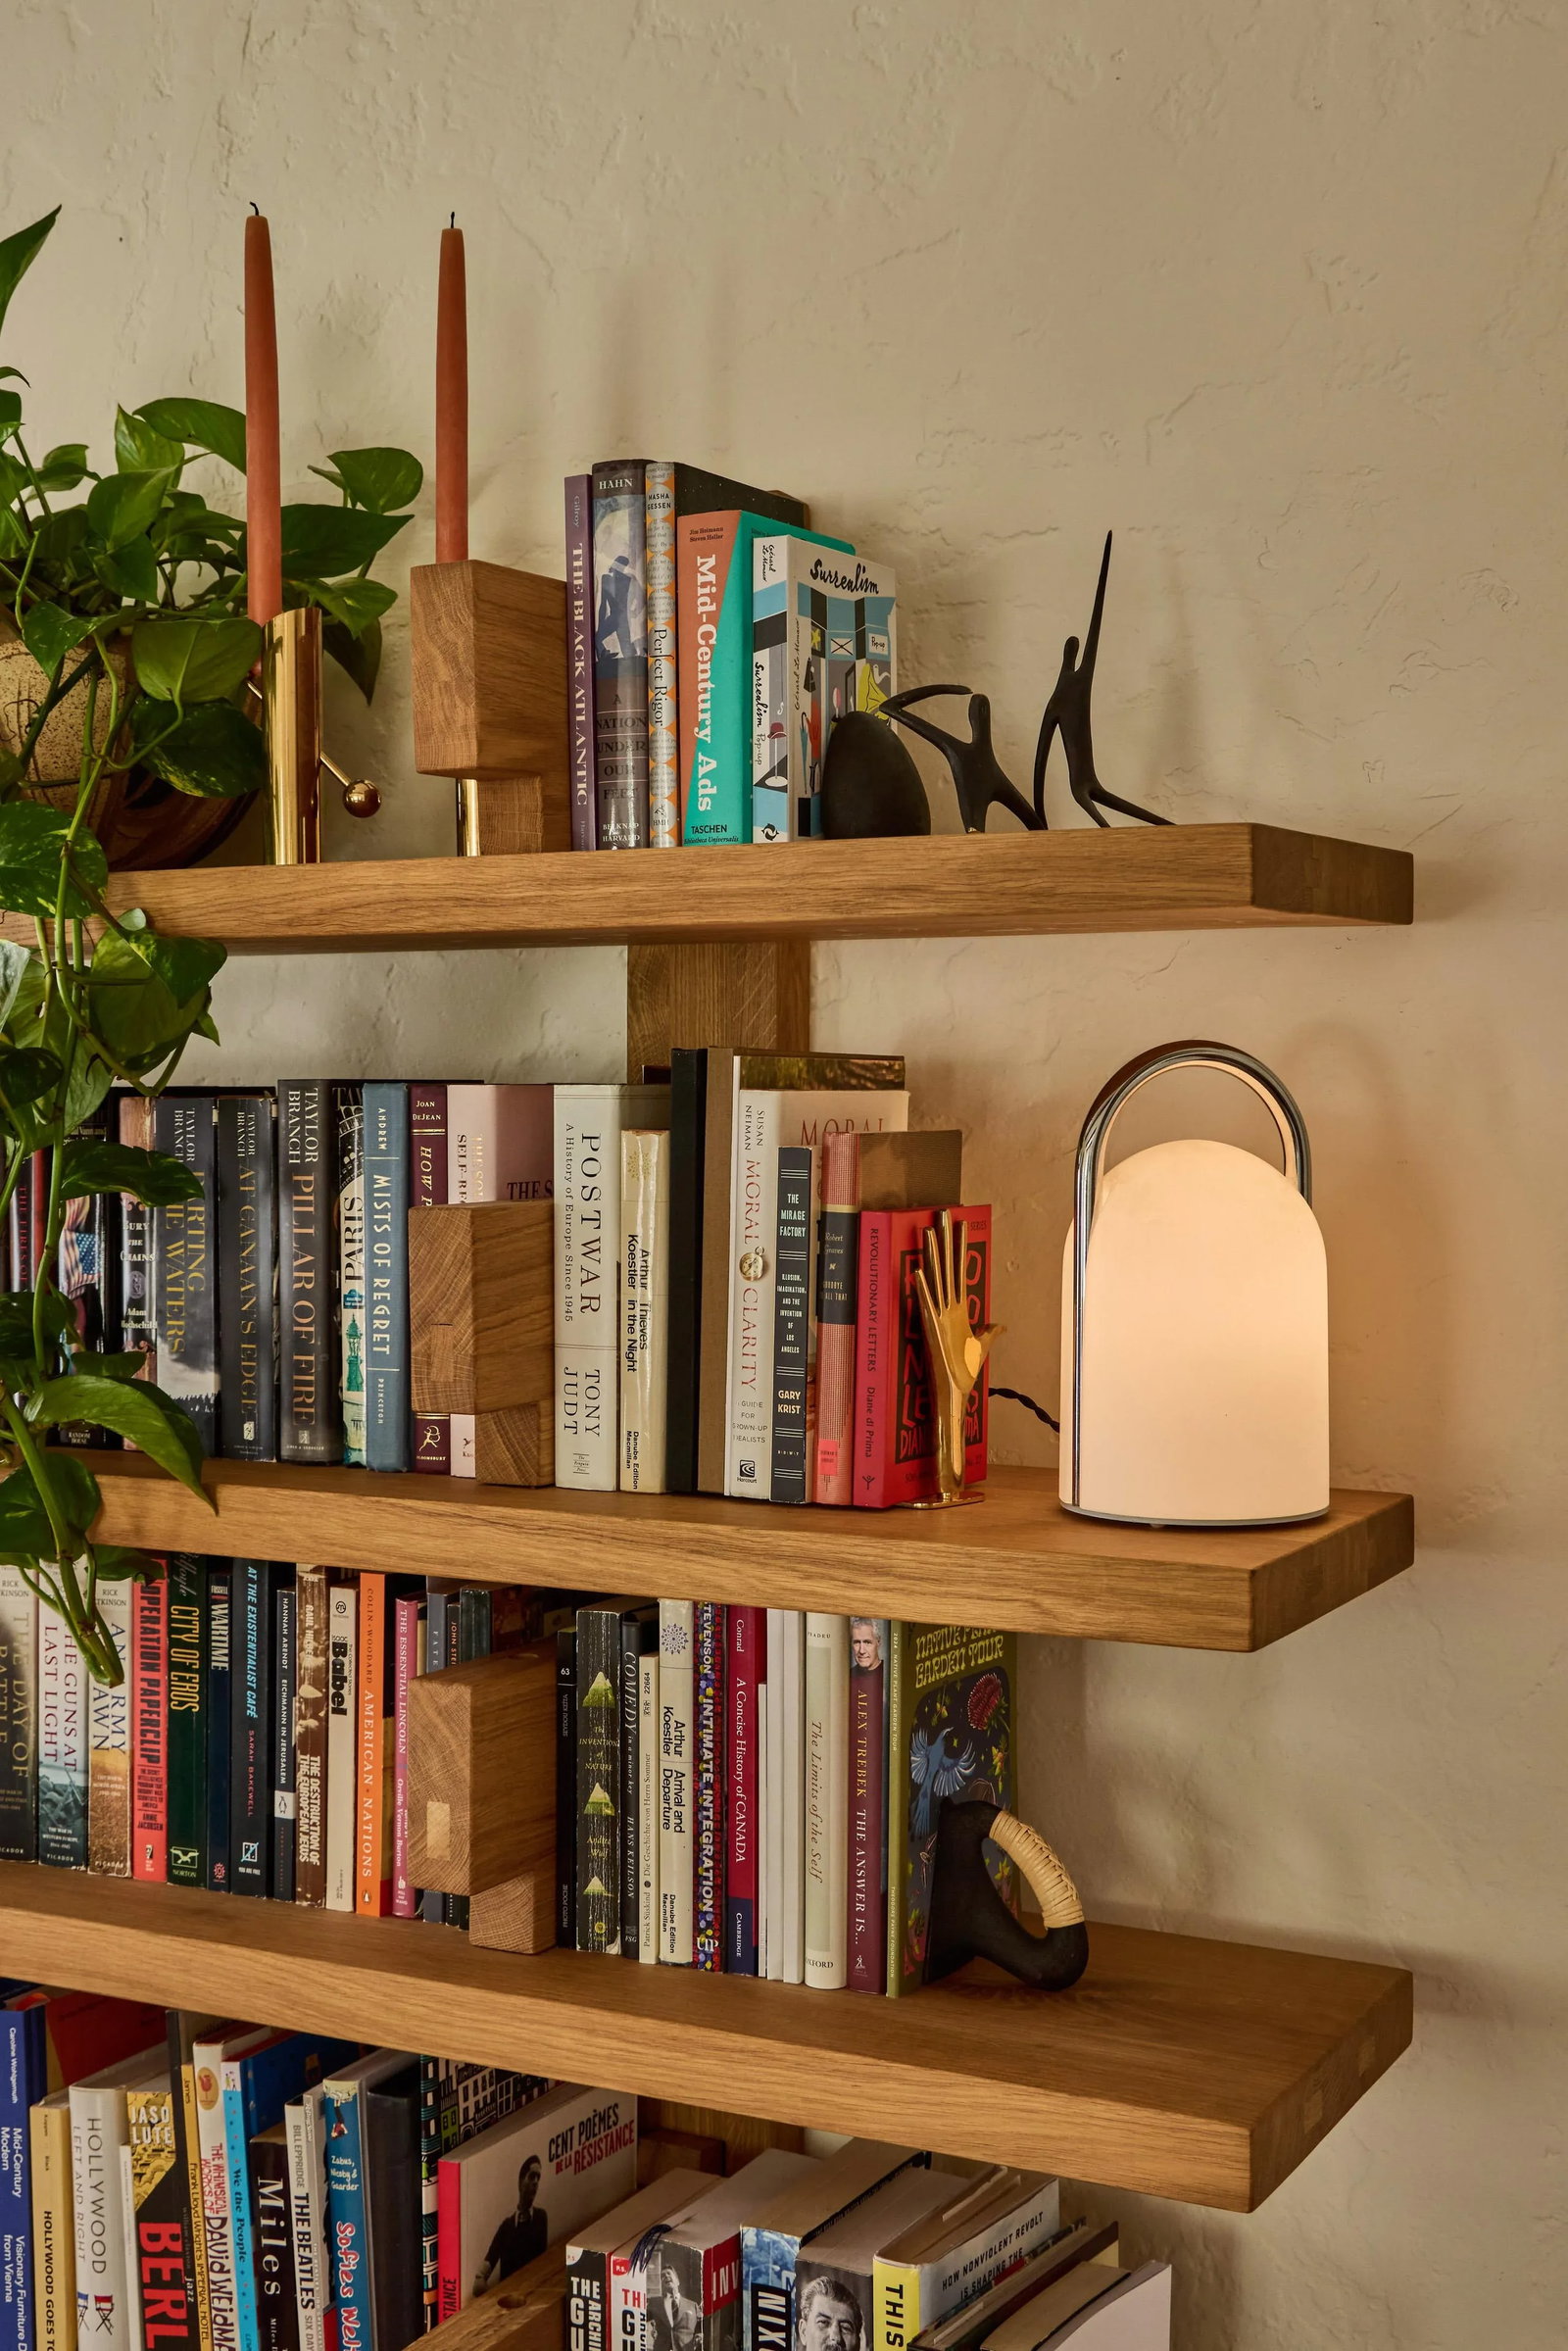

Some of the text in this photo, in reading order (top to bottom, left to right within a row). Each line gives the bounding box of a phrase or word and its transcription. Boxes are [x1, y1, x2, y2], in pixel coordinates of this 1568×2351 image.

[599, 478, 633, 490] HAHN
[572, 542, 584, 594] THE
[809, 559, 879, 595] Surrealism
[573, 600, 586, 678] BLACK
[694, 554, 717, 812] Mid-Century Ads
[575, 684, 588, 806] ATLANTIC
[596, 716, 647, 731] NATION
[597, 740, 647, 754] UNDER
[691, 824, 727, 835] TASCHEN
[186, 1107, 195, 1161] TAYLOR
[288, 1091, 301, 1164] BRANCH
[305, 1088, 318, 1163] TAYLOR
[565, 1123, 574, 1132] A
[757, 1109, 765, 1147] SUSAN
[420, 1146, 432, 1191] HOW
[564, 1137, 574, 1183] History
[565, 1187, 573, 1200] of
[580, 1133, 602, 1314] POSTWAR
[780, 1208, 806, 1221] MIRAGE
[788, 1194, 799, 1203] THE
[344, 1196, 364, 1284] PARIS
[564, 1204, 574, 1249] Europe
[779, 1226, 806, 1238] FACTORY
[239, 1165, 257, 1414] AT CANAAN'S EDGE
[372, 1174, 391, 1355] MISTS OF REGRET
[627, 1234, 638, 1290] Koestler
[640, 1249, 650, 1291] Arthur
[741, 1159, 760, 1392] MORAL CLARITY
[166, 1240, 186, 1352] WATERS
[292, 1173, 315, 1426] PILLAR OF FIRE
[564, 1296, 573, 1322] 1945
[639, 1301, 651, 1350] Thieves
[866, 1228, 879, 1372] REVOLUTIONARY LETTERS
[625, 1299, 637, 1373] in the Night
[564, 1366, 578, 1435] JUDT
[585, 1369, 601, 1437] TONY
[777, 1403, 802, 1414] KRIST
[778, 1390, 802, 1400] GARY
[171, 1605, 199, 1712] CITY OF EROS
[211, 1603, 229, 1671] WARTIME
[246, 1566, 259, 1719] AT THE EXISTENTIALIST CAFÉ
[915, 1635, 1004, 1689] GARDEN TOUR
[44, 1627, 58, 1763] LAST LIGHT
[140, 1584, 161, 1765] OPERATION PAPERCLIP
[331, 1641, 348, 1716] Babel
[398, 1609, 408, 1754] THE ESSENTIAL LINCOLN
[624, 1651, 637, 1735] COMEDY
[579, 1738, 618, 1747] INVENTION
[663, 1706, 674, 1756] Koestler
[673, 1720, 686, 1757] Arthur
[703, 1698, 713, 1784] INTIMATE
[733, 1619, 747, 1863] Conrad A Concise History of CANADA
[858, 1690, 868, 1730] ALEX
[362, 1690, 374, 1878] AMERICAN NATIONS
[662, 1768, 673, 1831] Departure
[857, 1737, 868, 1797] TREBEK
[310, 1755, 320, 1866] THE DESTRUCTION OF
[673, 1769, 686, 1834] Arrival and
[856, 1809, 866, 1841] THE
[702, 1789, 713, 1913] INTEGRATION
[855, 1847, 866, 1912] ANSWER
[331, 2155, 355, 2168] Zabus,
[548, 2103, 619, 2163] CENT POÈMES
[555, 2120, 635, 2176] DE LA RÉSISTANCE
[87, 2118, 107, 2274] HOLLYWOOD
[294, 2144, 305, 2189] EPPRIDGE
[0, 2127, 13, 2303] Modern from Vienna
[12, 2128, 26, 2341] Mid-Century Visionary Furniture
[233, 2168, 247, 2263] We the People
[258, 2176, 287, 2295] Miles
[294, 2192, 311, 2228] THE
[44, 2210, 54, 2295] HOLLYWOOD
[296, 2230, 315, 2310] BEATLES
[336, 2221, 360, 2298] Sofies
[942, 2211, 1044, 2292] HOW NONVIOLENT REVOLT
[46, 2299, 55, 2335] GOES
[139, 2223, 188, 2351] BERL
[570, 2277, 601, 2299] THE
[885, 2283, 904, 2348] THIS
[305, 2315, 314, 2330] SIX
